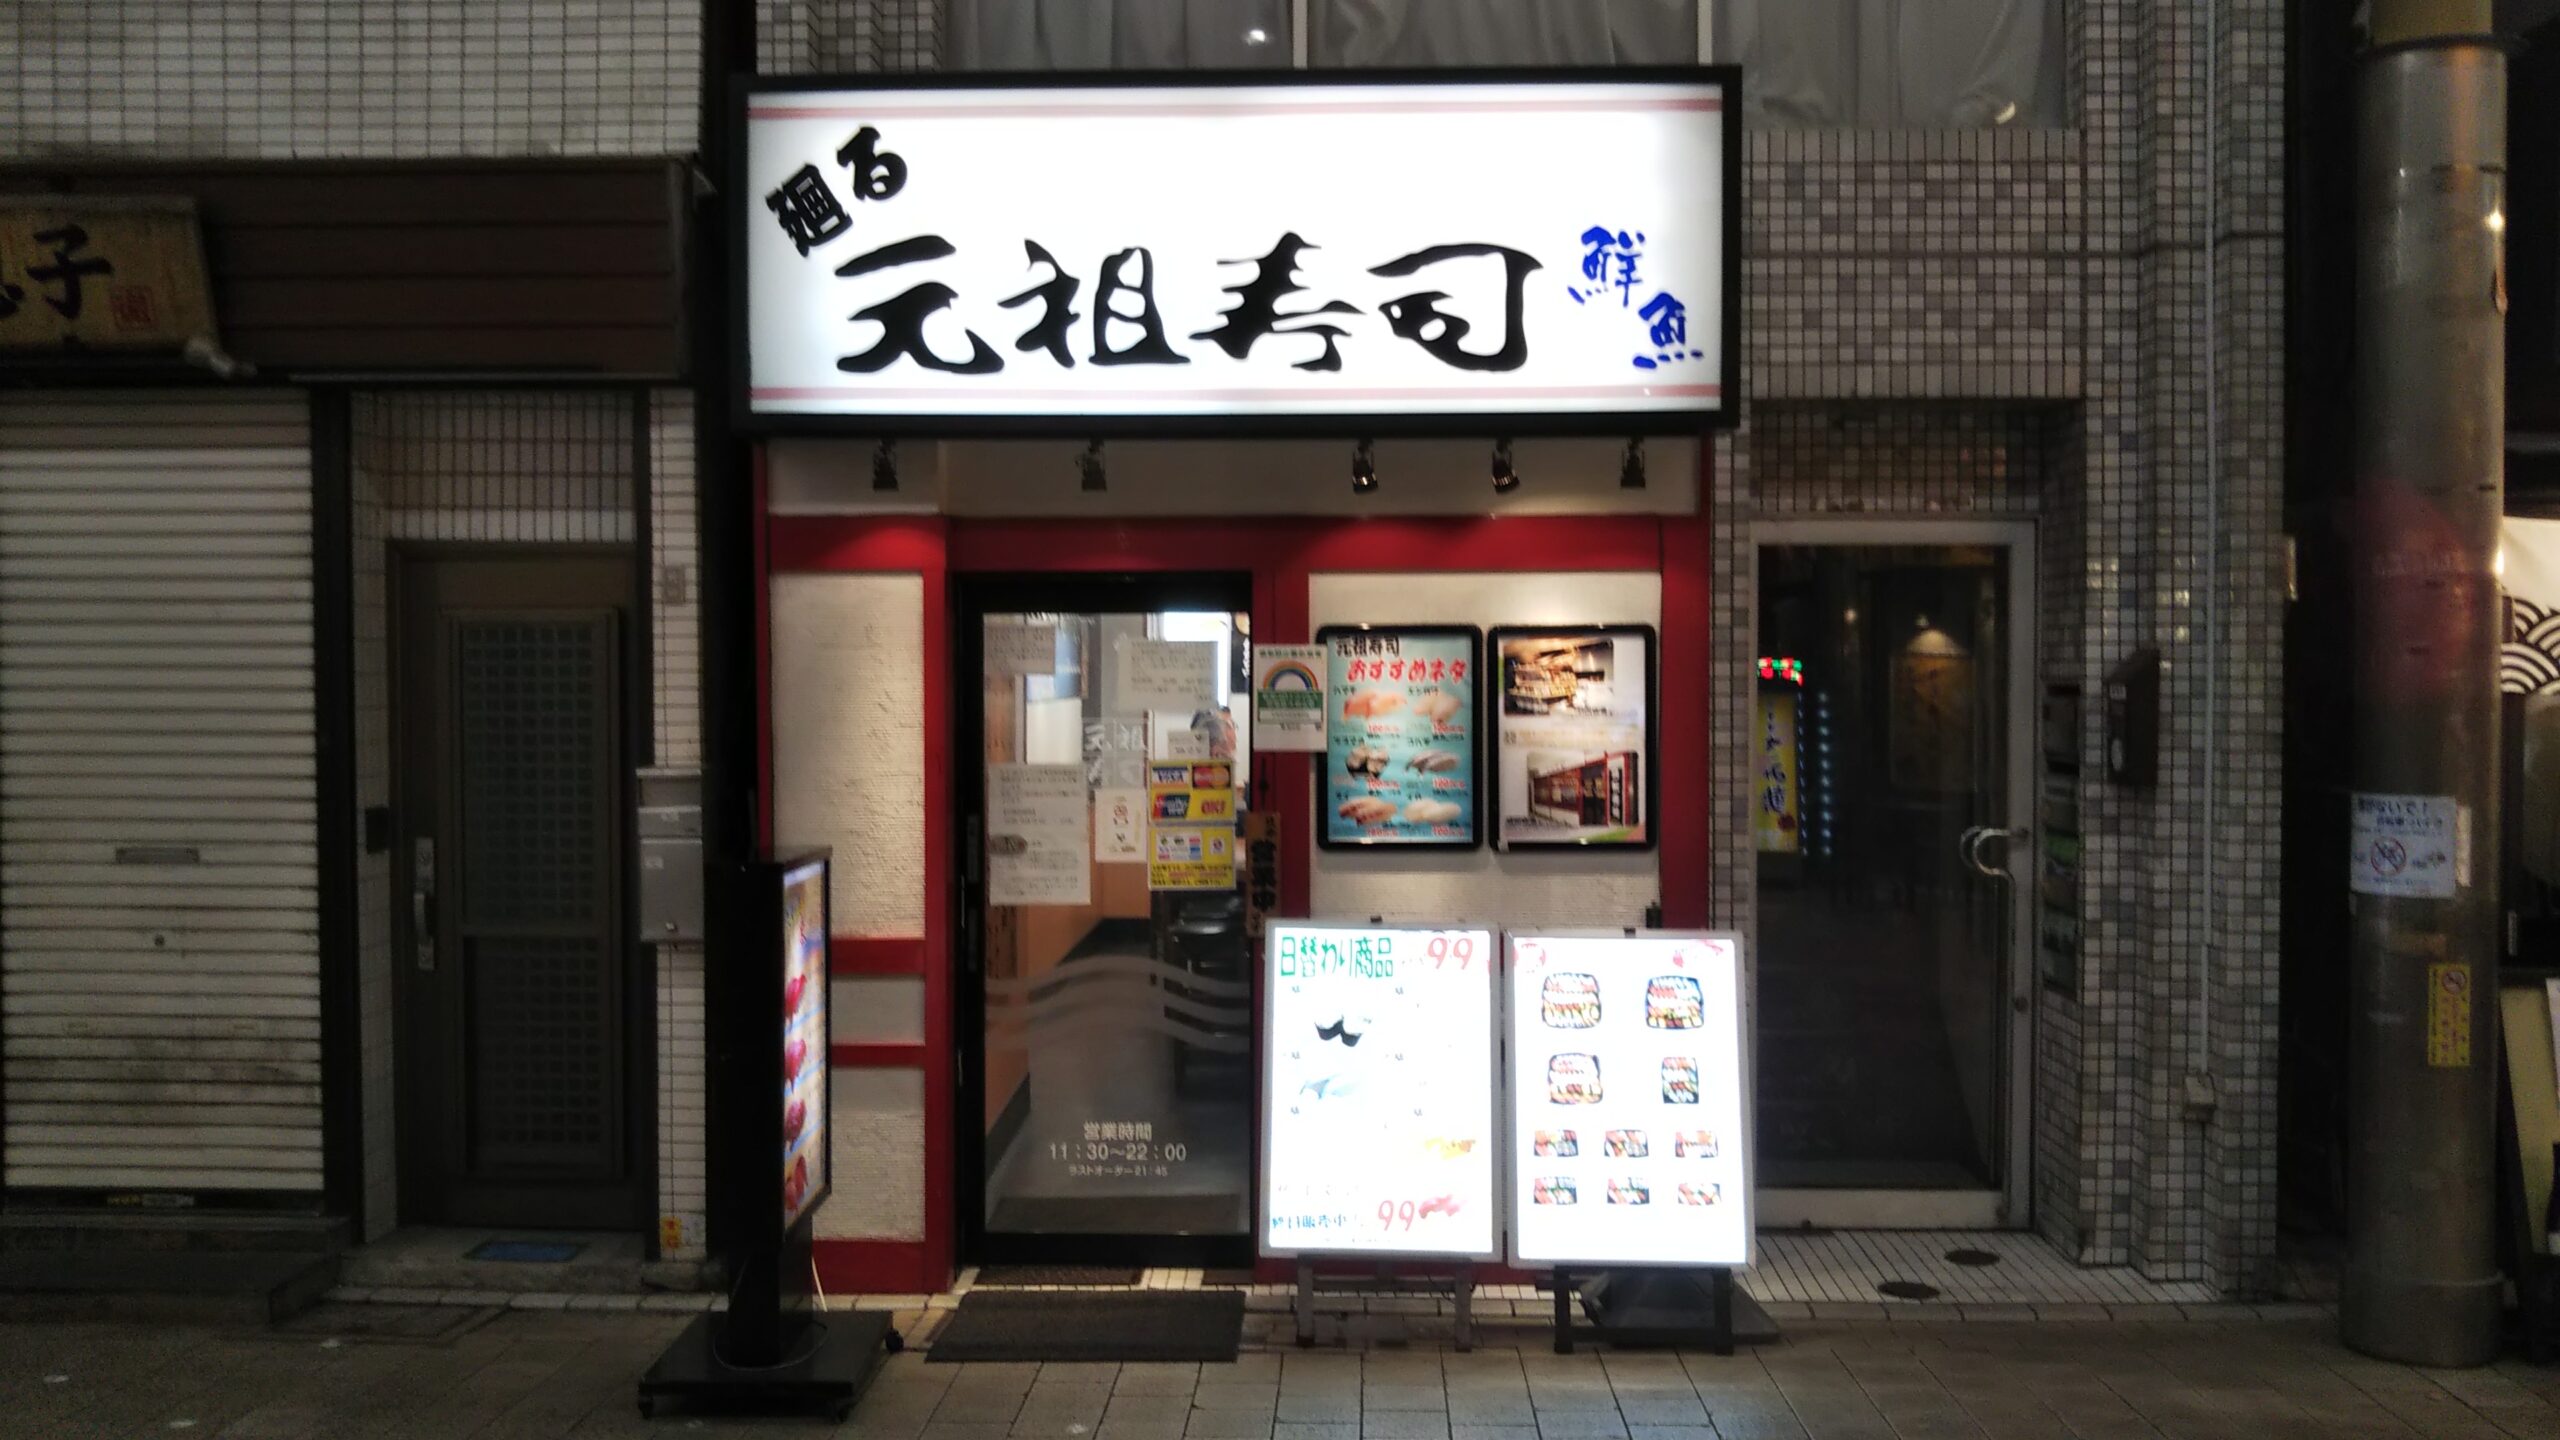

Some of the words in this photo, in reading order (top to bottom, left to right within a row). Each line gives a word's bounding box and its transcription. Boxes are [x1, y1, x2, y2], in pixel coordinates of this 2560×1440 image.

[765, 126, 908, 257] 廻る
[834, 231, 1545, 375] 元祖寿司
[1568, 225, 1704, 371] 鮮魚
[1336, 635, 1400, 657] 元祖寿司
[1347, 658, 1468, 683] おすすめネタ
[1156, 768, 1186, 784] VISA
[1280, 936, 1394, 978] 日替わり商品
[1083, 1121, 1152, 1142] 営業時間
